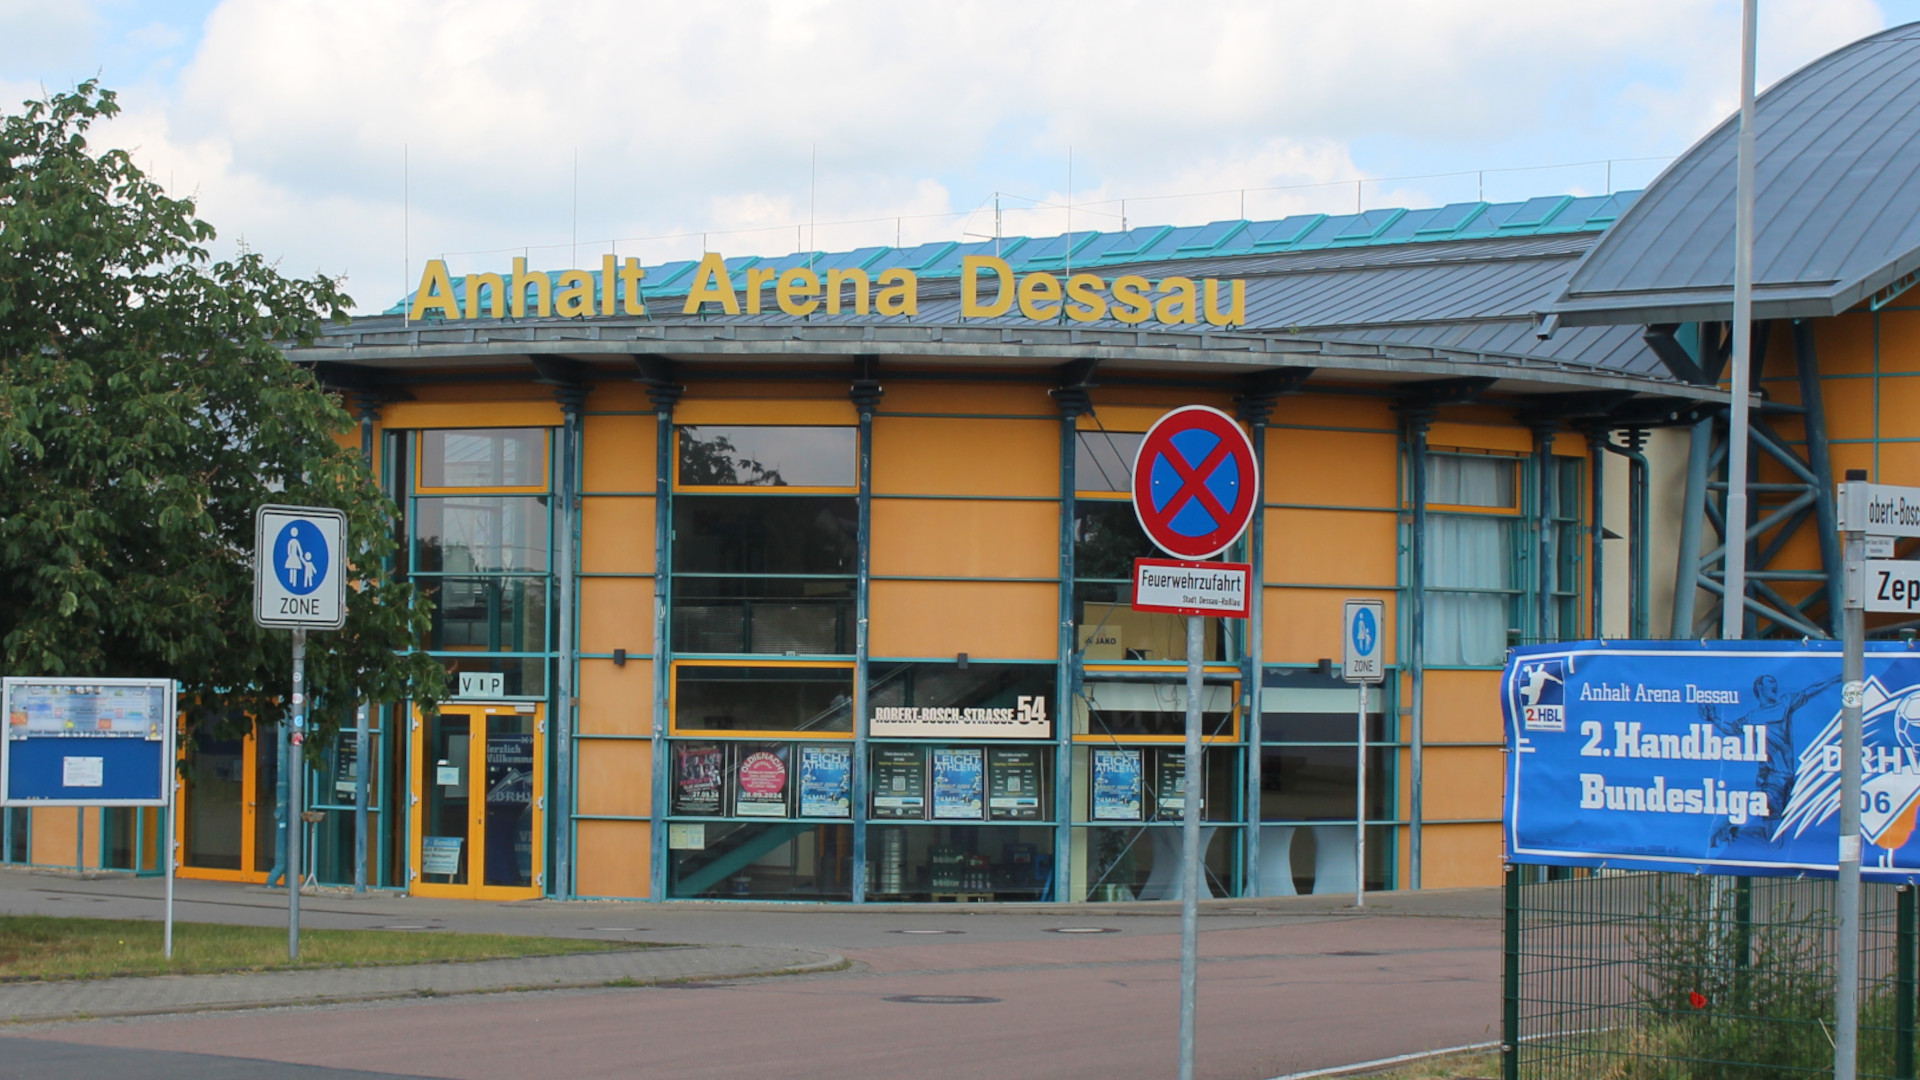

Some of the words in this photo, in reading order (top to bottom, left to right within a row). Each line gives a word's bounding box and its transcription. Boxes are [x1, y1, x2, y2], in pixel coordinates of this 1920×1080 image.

[409, 253, 646, 320] Anhalt
[682, 252, 919, 317] Arena
[962, 255, 1246, 326] Dessau
[1142, 569, 1242, 592] Feuerwehrzufahrt
[280, 597, 320, 616] ZONE
[1182, 595, 1197, 604] Stadt
[1095, 637, 1117, 645] JAKO
[1354, 659, 1374, 672] ZONE
[462, 677, 501, 692] VIP
[1580, 682, 1630, 702] Anhalt
[1635, 683, 1681, 703] Arena
[1686, 684, 1740, 704] Dessau
[875, 706, 1014, 725] ROBERT-BOSCH-STRASSE
[1017, 695, 1046, 725] 54
[741, 752, 786, 774] OLDIENACHT
[803, 753, 849, 763] LEICHT
[934, 755, 981, 765] LEICHT
[1095, 756, 1139, 766] LEICHT
[803, 761, 849, 770] ATHLETIK
[935, 763, 981, 772] ATHLETIK
[1580, 773, 1769, 825] Bundesliga
